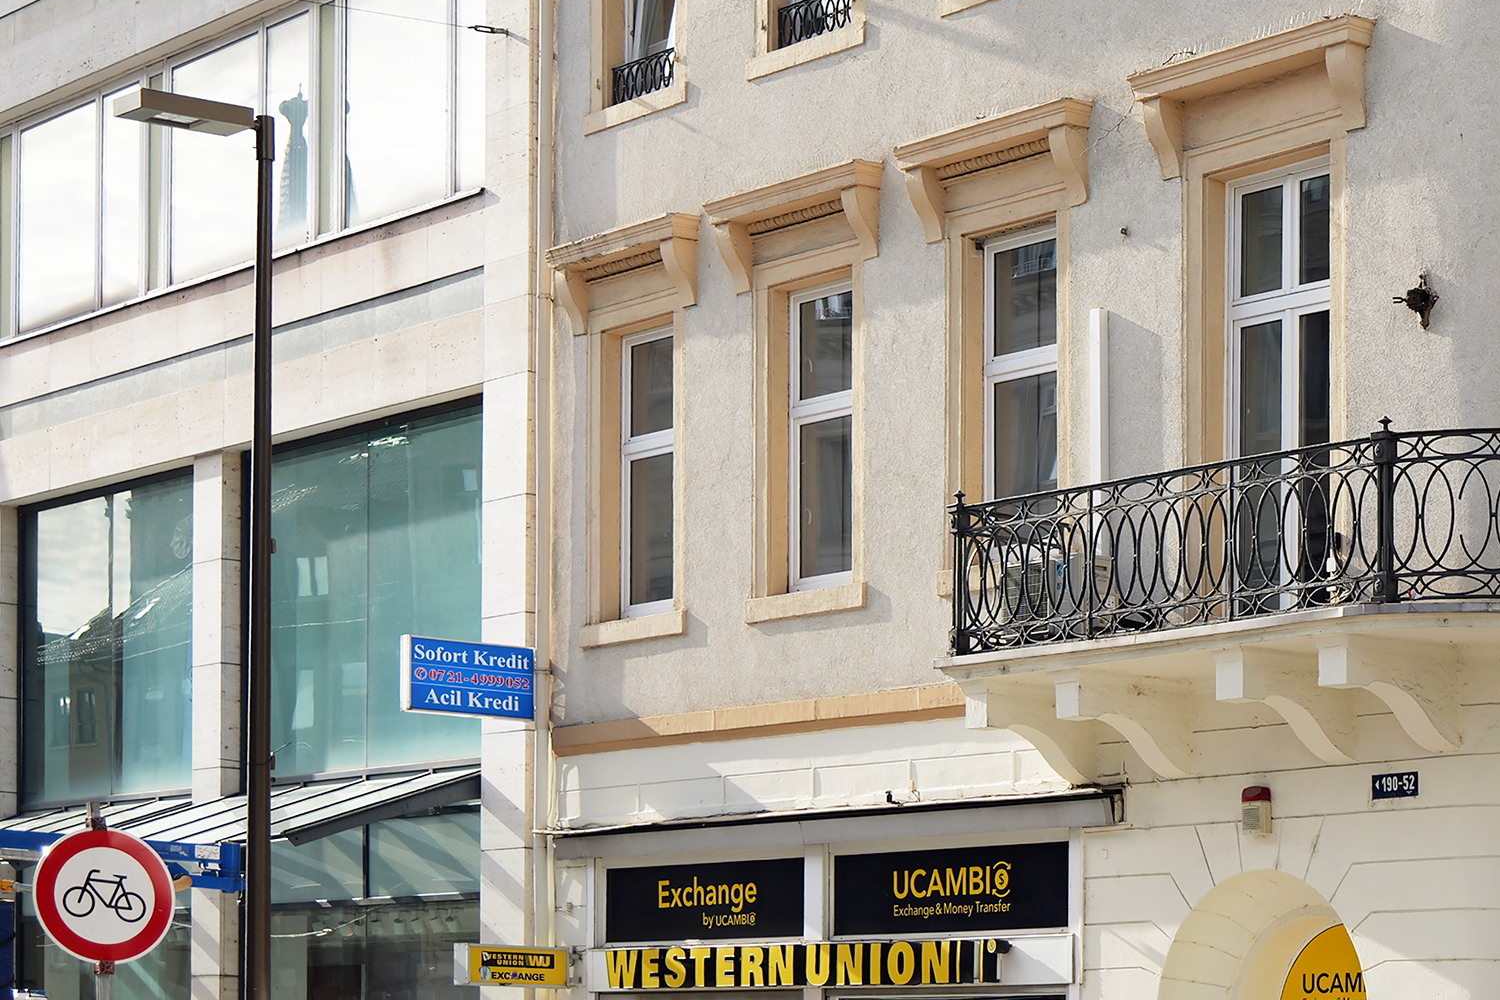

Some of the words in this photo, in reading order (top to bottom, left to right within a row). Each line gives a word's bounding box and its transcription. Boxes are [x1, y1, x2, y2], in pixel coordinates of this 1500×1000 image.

[414, 644, 468, 664] Sofort
[474, 650, 529, 670] Kredit
[429, 668, 530, 690] 0721-4999052
[425, 689, 462, 706] Acil
[467, 692, 519, 711] Kredi
[1382, 775, 1415, 792] 190-52
[658, 876, 757, 913] Exchange
[893, 903, 934, 919] Exchange
[935, 902, 942, 914] &
[943, 902, 973, 917] Money
[975, 899, 1011, 913] Transfer
[702, 912, 714, 929] by
[529, 955, 551, 967] WU
[606, 945, 794, 988] WESTERN
[806, 941, 949, 986] UNION
[491, 971, 545, 981] EXCANGE
[1303, 972, 1367, 994] UCAM
